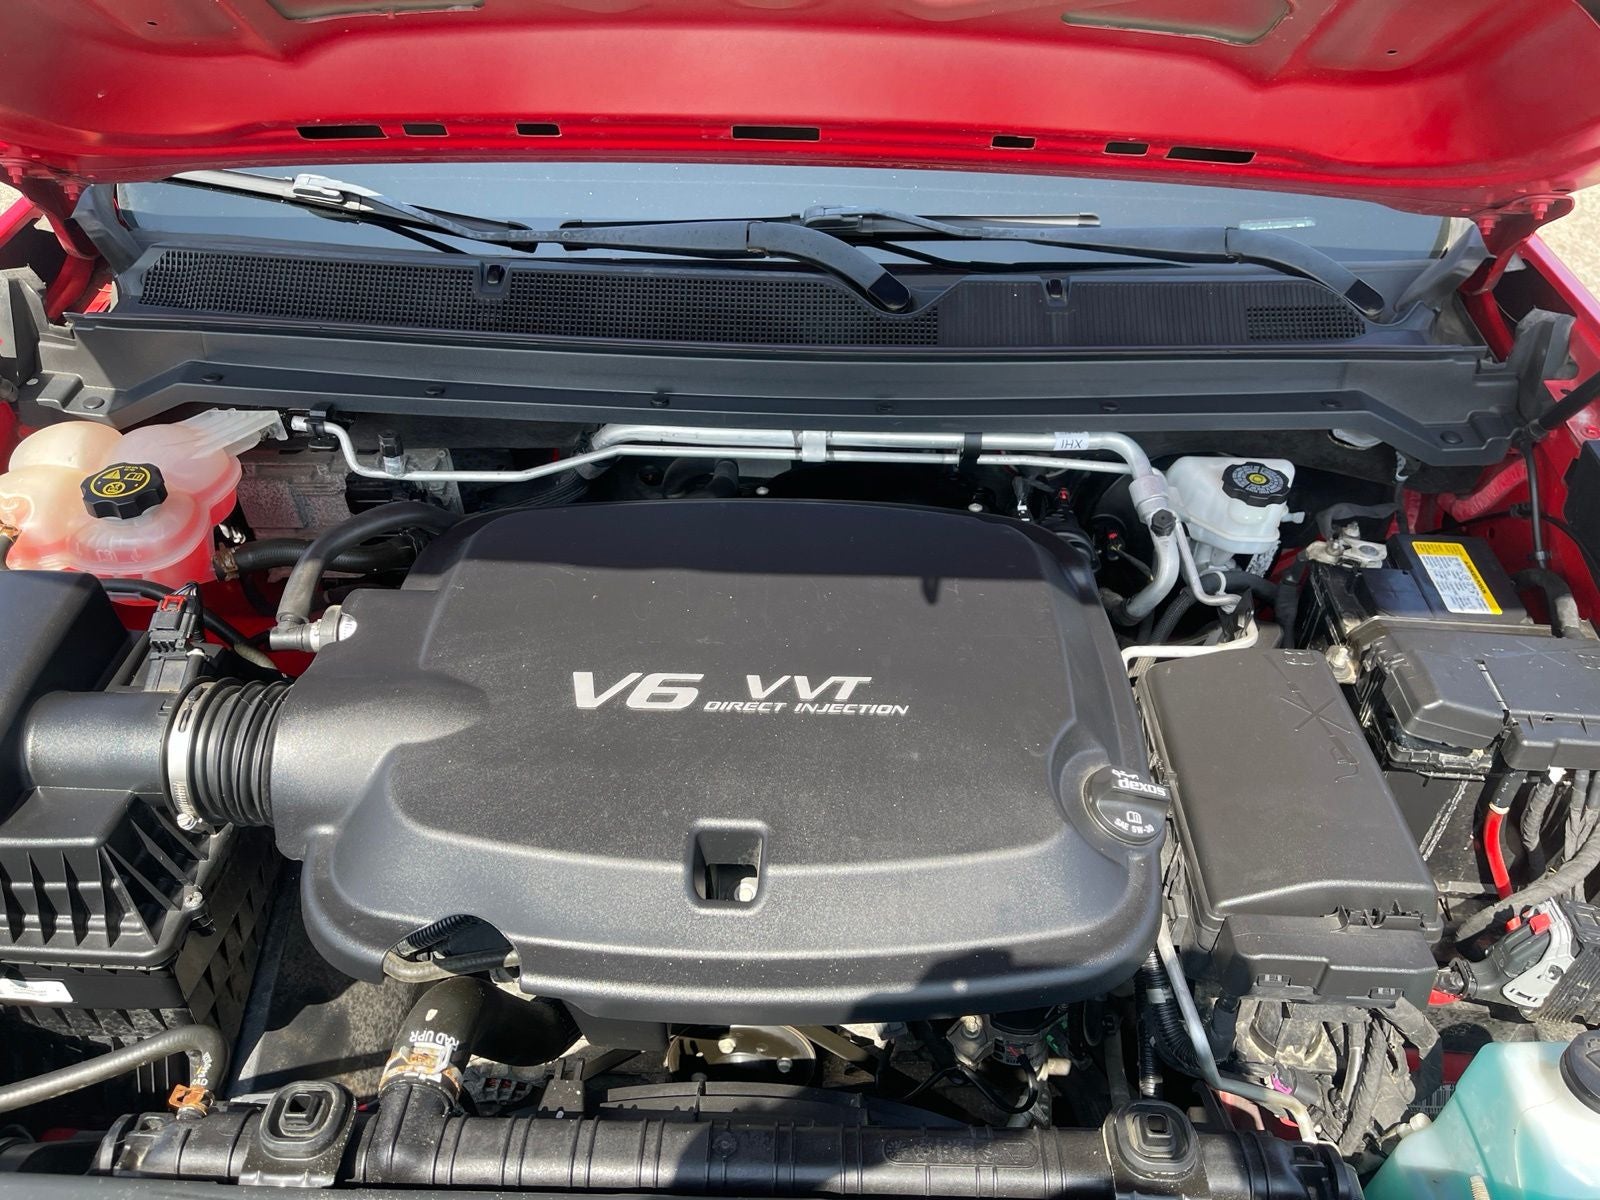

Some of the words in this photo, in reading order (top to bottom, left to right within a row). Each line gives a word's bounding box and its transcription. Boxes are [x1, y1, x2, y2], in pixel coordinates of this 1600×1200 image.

[573, 671, 704, 710] V6
[746, 674, 872, 701] VVT
[703, 700, 787, 714] DIRECT
[794, 702, 909, 716] INJECTION
[1118, 777, 1166, 796] dexos
[1114, 818, 1129, 831] SAE
[409, 1030, 434, 1043] UPR
